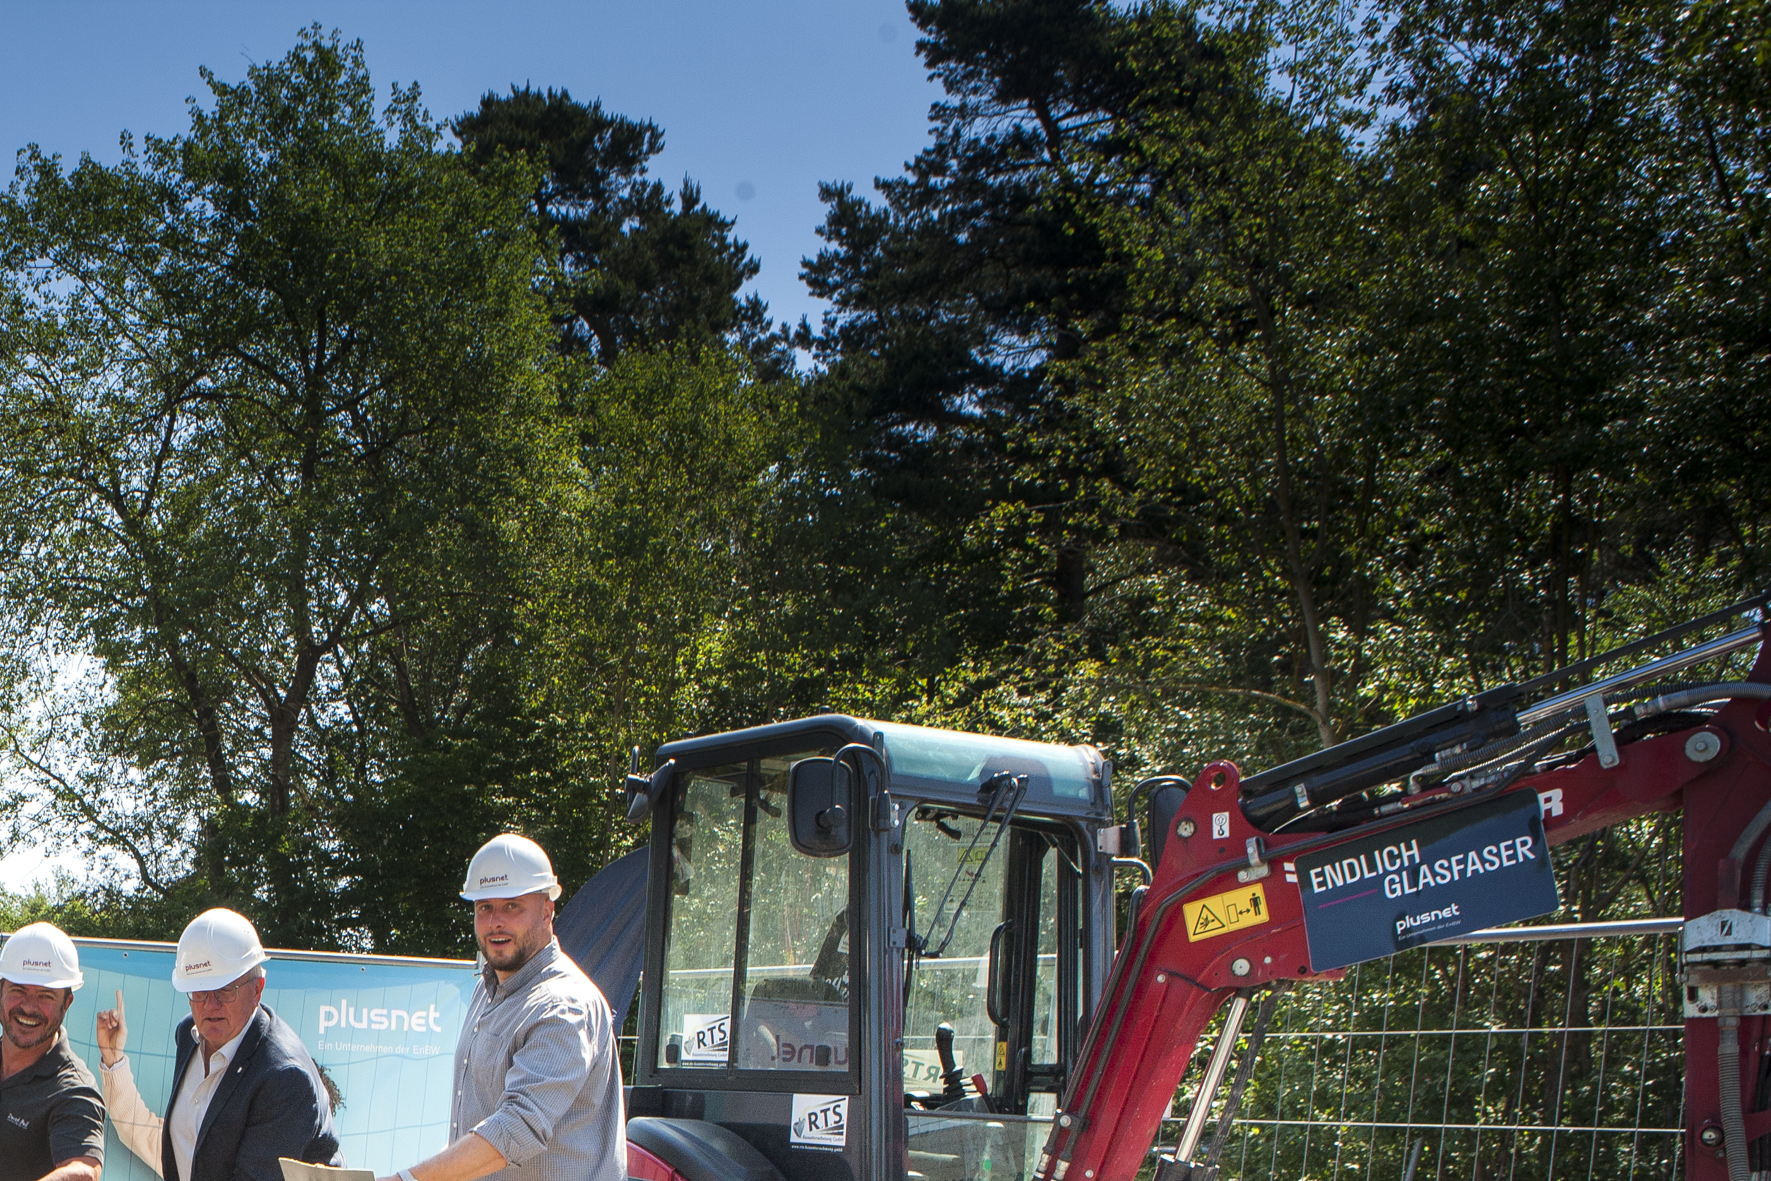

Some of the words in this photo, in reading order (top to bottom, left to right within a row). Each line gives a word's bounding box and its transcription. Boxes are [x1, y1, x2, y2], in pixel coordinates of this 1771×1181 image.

[1309, 839, 1421, 894] ENDLICH
[1384, 835, 1536, 899] GLASFASER
[479, 873, 509, 886] plusnet
[1395, 902, 1461, 935] plusnet
[22, 958, 52, 968] plusnet
[185, 959, 212, 973] plusnet
[318, 998, 442, 1035] plusnet
[318, 1040, 333, 1050] Ein
[335, 1041, 394, 1054] Unternehmen
[395, 1044, 410, 1054] der
[413, 1045, 441, 1055] EnBW
